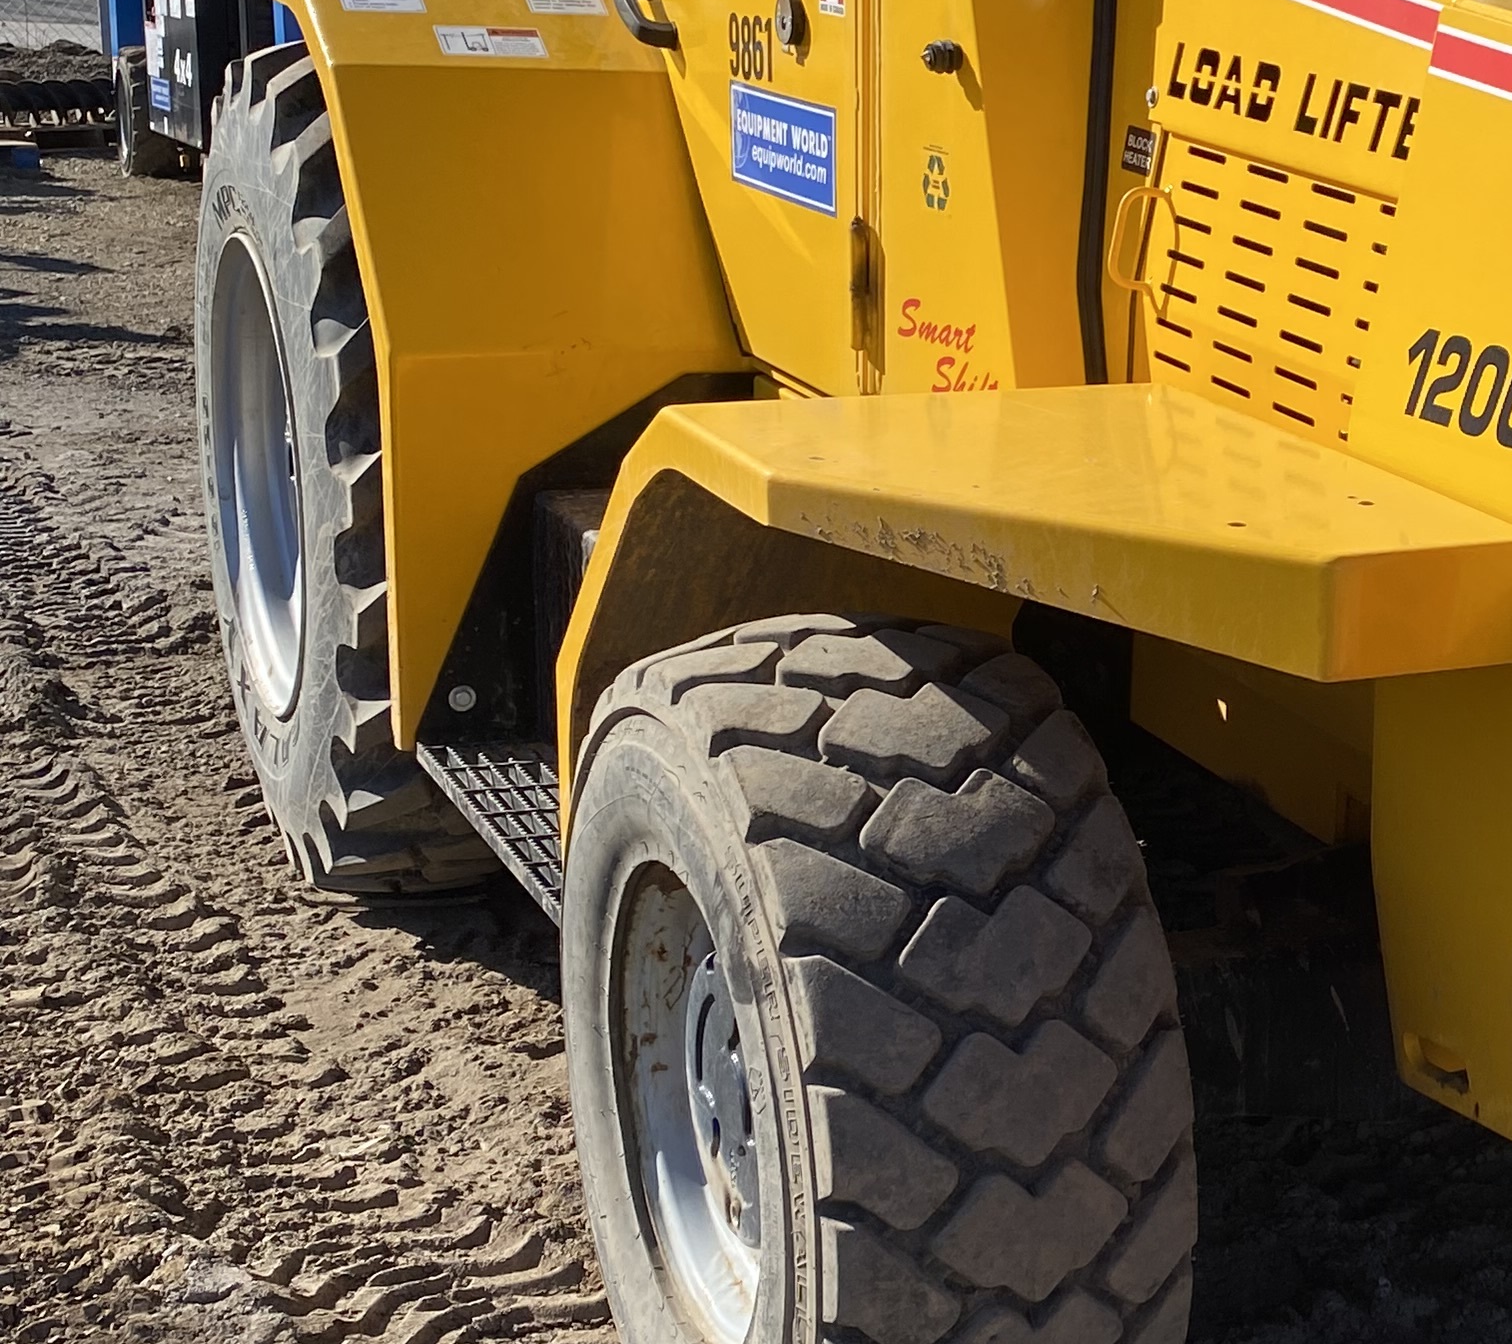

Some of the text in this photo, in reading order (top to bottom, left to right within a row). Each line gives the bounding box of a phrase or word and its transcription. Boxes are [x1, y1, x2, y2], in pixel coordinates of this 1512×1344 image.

[174, 47, 193, 88] 4x4
[729, 12, 774, 83] 9861
[1167, 41, 1281, 123] LOAD
[736, 108, 829, 159] EQUIPMENT WORLD
[1127, 134, 1154, 154] BLOCK
[751, 144, 827, 185] equipworld.com
[1124, 150, 1152, 170] HEATER
[897, 298, 976, 354] Smart
